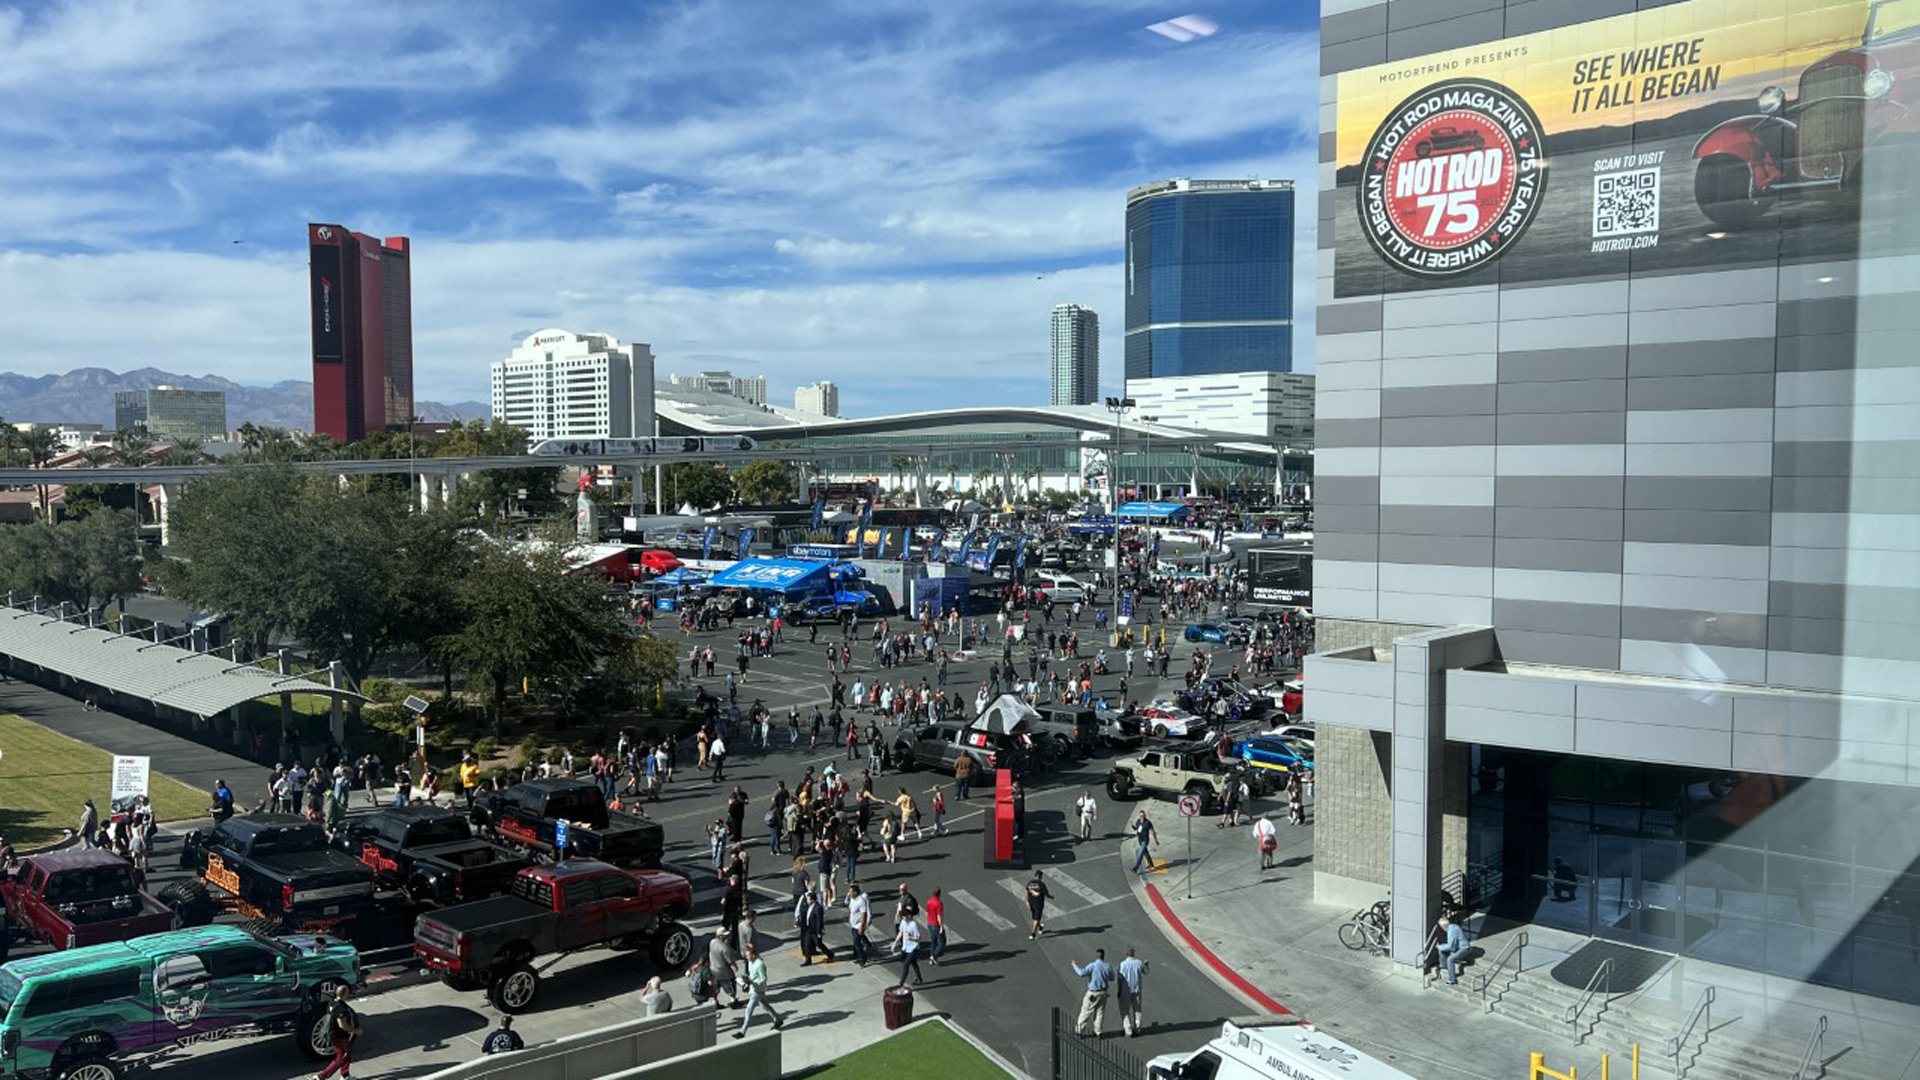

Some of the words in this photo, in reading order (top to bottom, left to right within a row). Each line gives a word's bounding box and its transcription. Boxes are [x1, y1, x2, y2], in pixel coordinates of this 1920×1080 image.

[1379, 60, 1459, 83] MOTORTREND
[1465, 46, 1529, 67] PRESENTS
[1573, 55, 1615, 86] SEE
[1620, 38, 1704, 77] WHERE
[1572, 87, 1594, 114] IT
[1595, 81, 1634, 110] ALL
[1641, 65, 1721, 102] BEGAN
[1376, 121, 1405, 160] HOT
[1404, 97, 1442, 127] ROD
[1444, 91, 1528, 139] MAGAZINE
[1519, 146, 1536, 172] 75
[1594, 158, 1620, 172] SCAN
[1623, 155, 1636, 167] TO
[1638, 151, 1666, 166] VISIT
[1369, 174, 1390, 237] BEGAN
[1417, 190, 1479, 237] 75
[1497, 172, 1536, 236] YEARS
[1386, 231, 1413, 257] ALL
[1427, 240, 1493, 268] WHERE
[1591, 235, 1659, 253] HOTROD.COM
[1408, 253, 1426, 266] IT
[1253, 587, 1310, 597] PERFORMANCE
[1253, 593, 1293, 601] UNLIMITED
